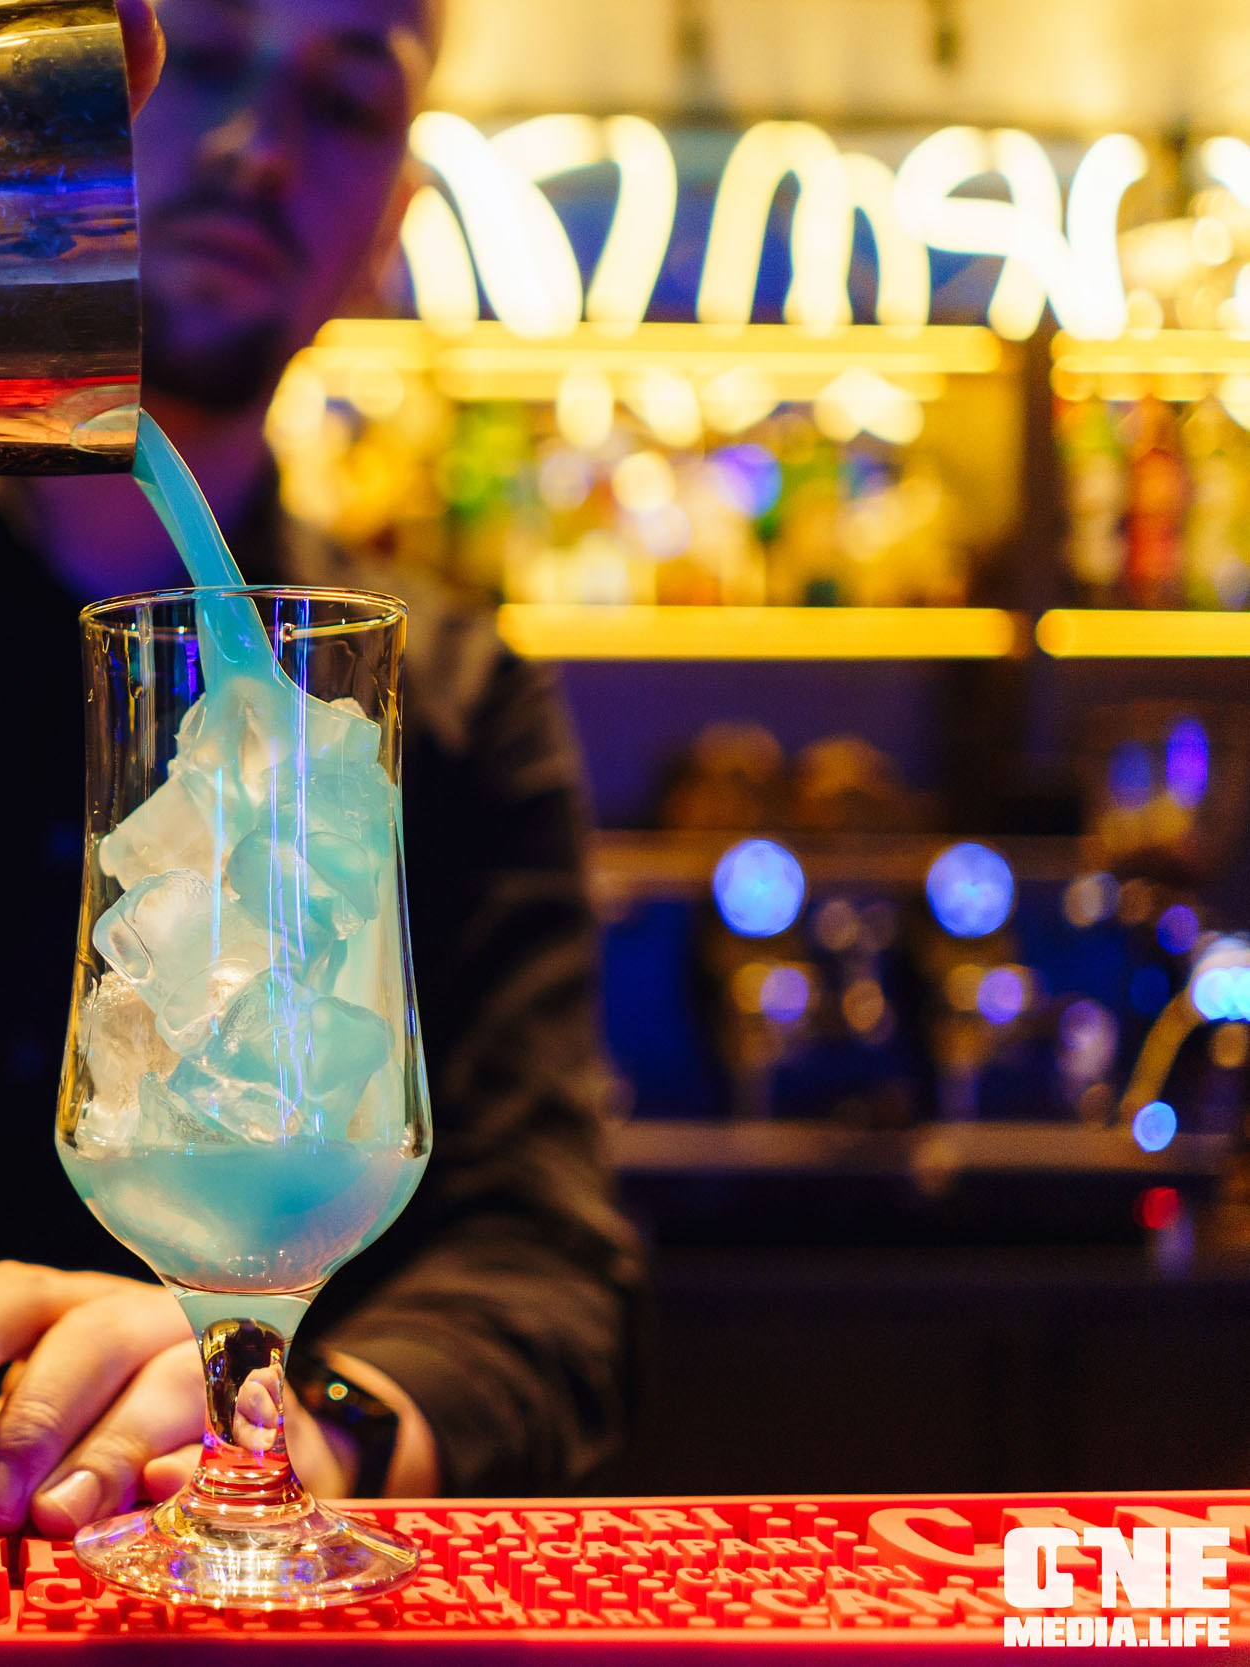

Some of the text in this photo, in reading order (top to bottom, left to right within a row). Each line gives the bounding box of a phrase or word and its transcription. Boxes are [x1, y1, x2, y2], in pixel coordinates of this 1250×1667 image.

[538, 1537, 834, 1558] CAMPARI
[675, 1565, 924, 1584] CAMPARI
[402, 1607, 663, 1627] CAMPARI
